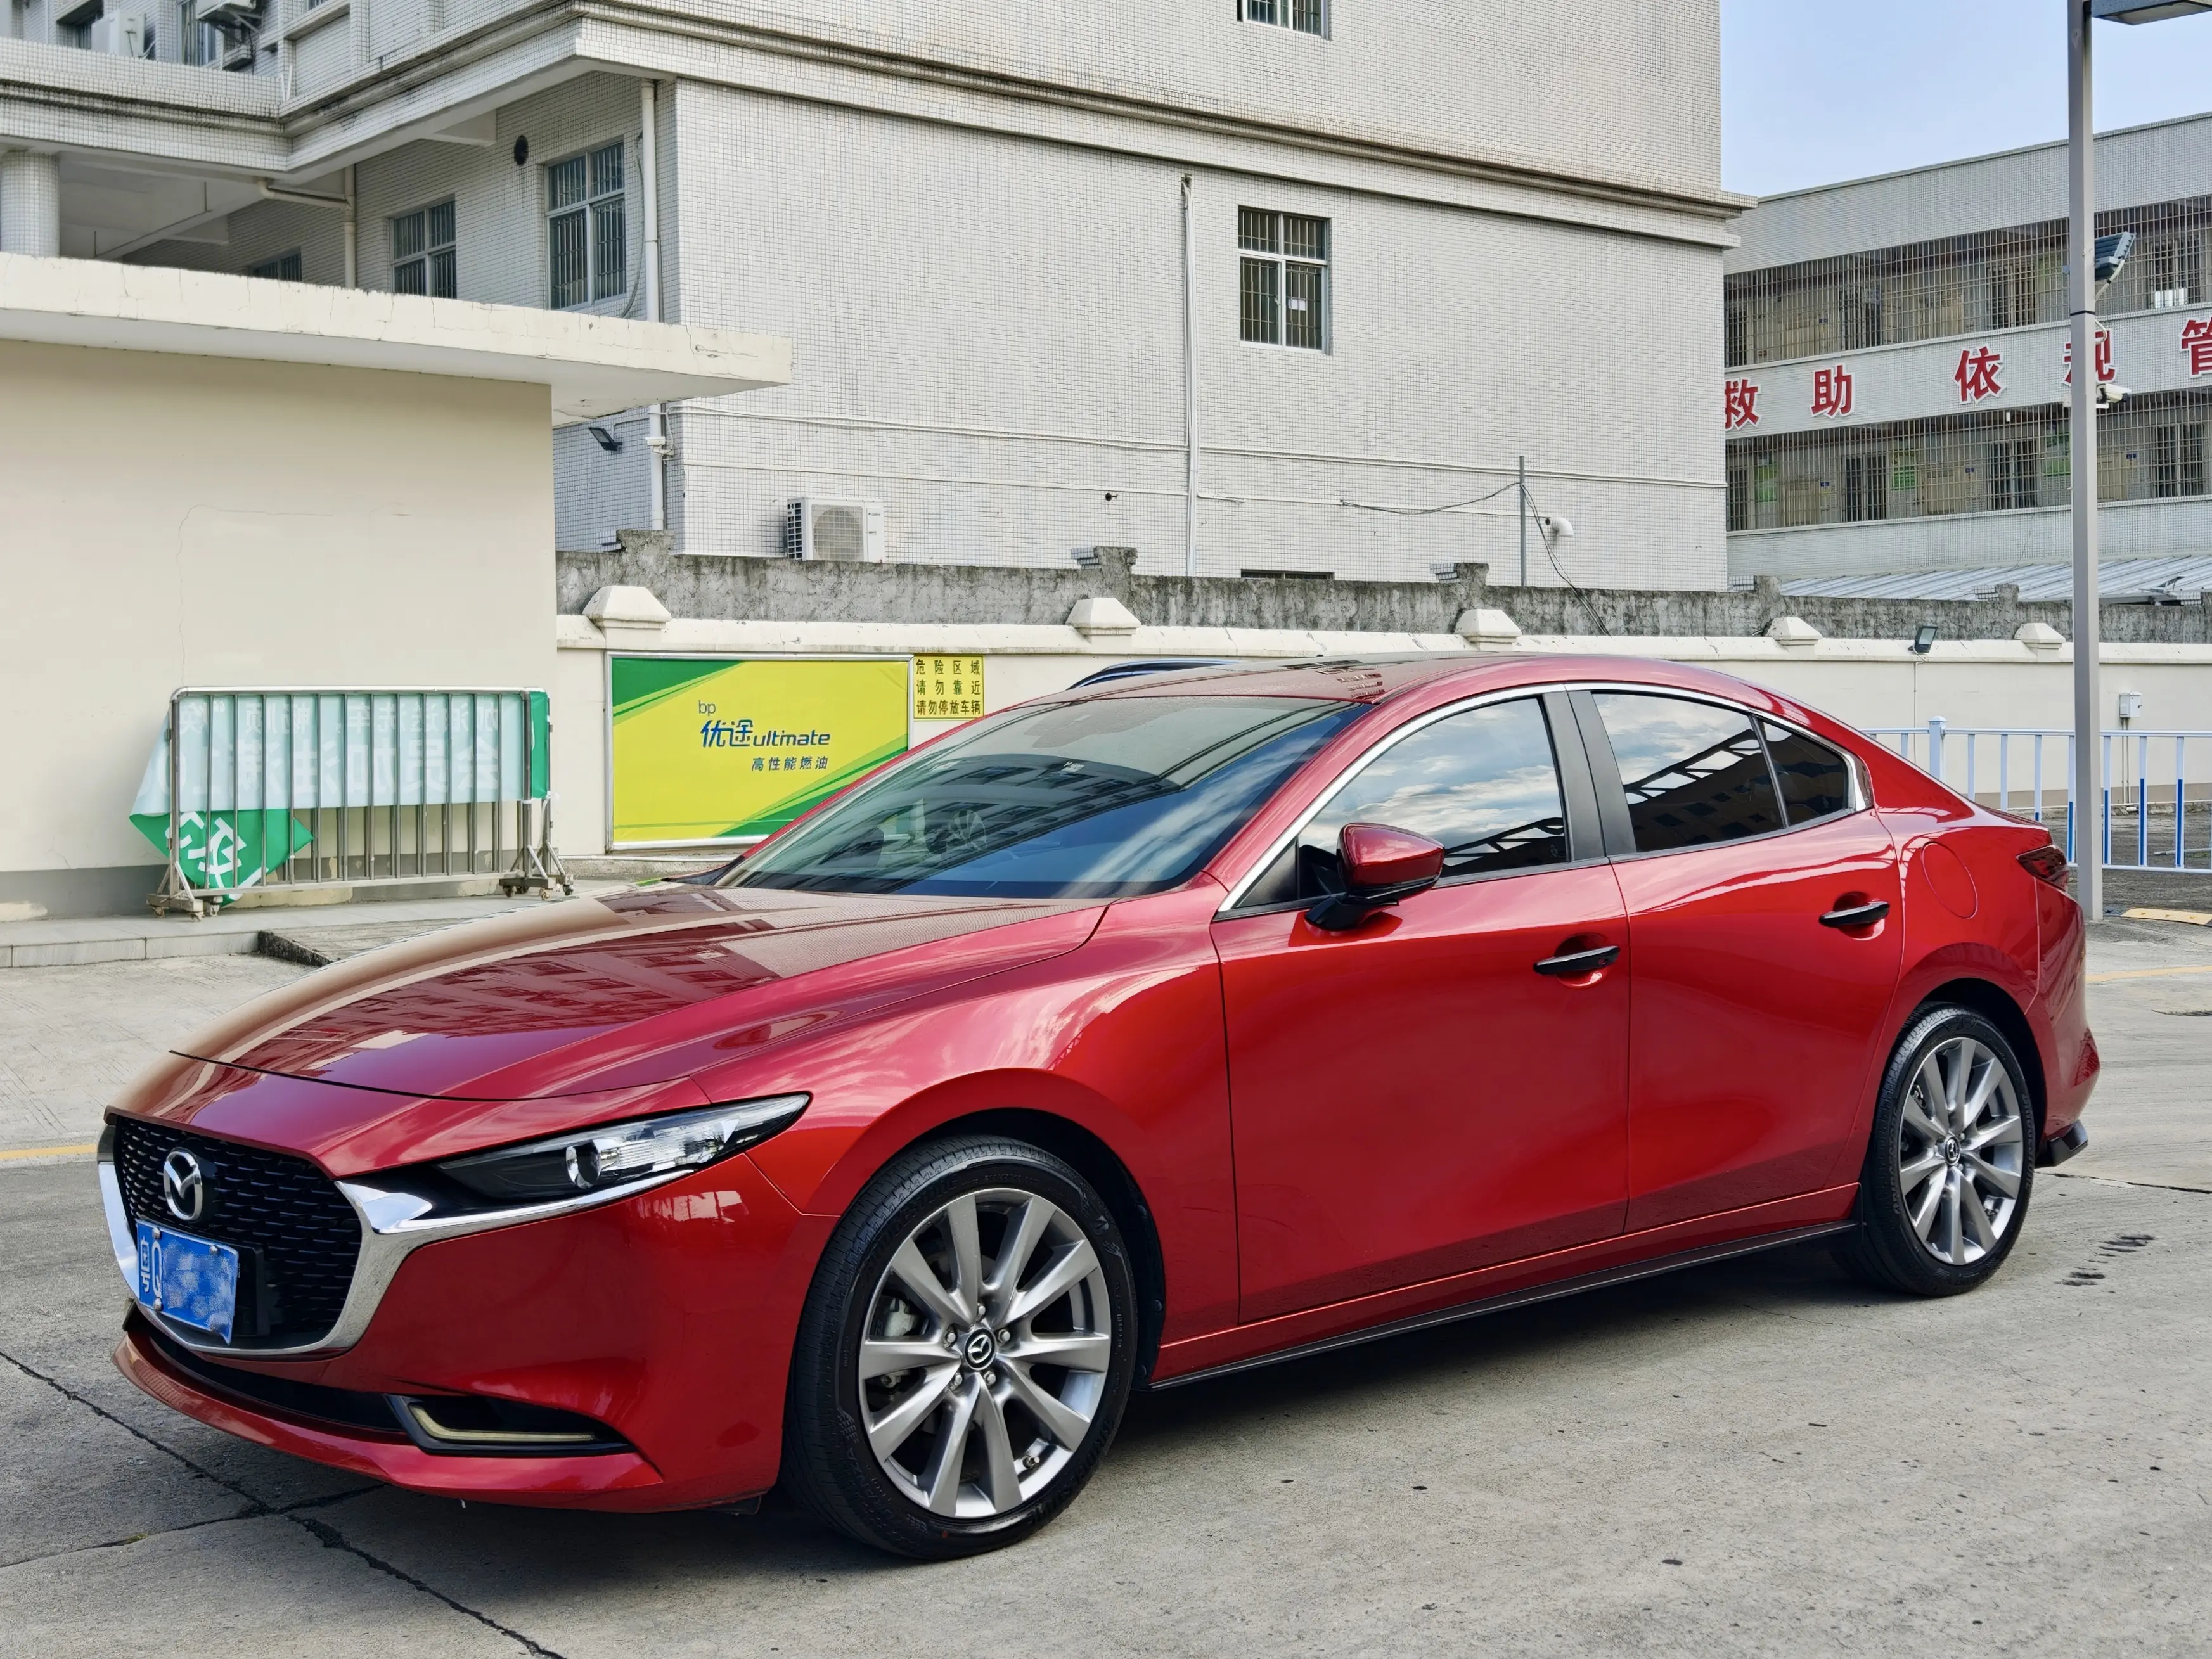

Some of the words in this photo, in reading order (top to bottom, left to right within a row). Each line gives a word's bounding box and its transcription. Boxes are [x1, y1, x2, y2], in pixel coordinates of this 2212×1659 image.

[1725, 364, 1853, 430] 救助
[916, 658, 981, 676] 危险区域
[916, 679, 981, 696] 请勿靠近
[698, 700, 716, 717] bp
[916, 699, 981, 715] 请勿停放车辆
[700, 719, 754, 748] 优途
[753, 729, 831, 747] ultimate
[751, 755, 829, 772] 高性能燃油
